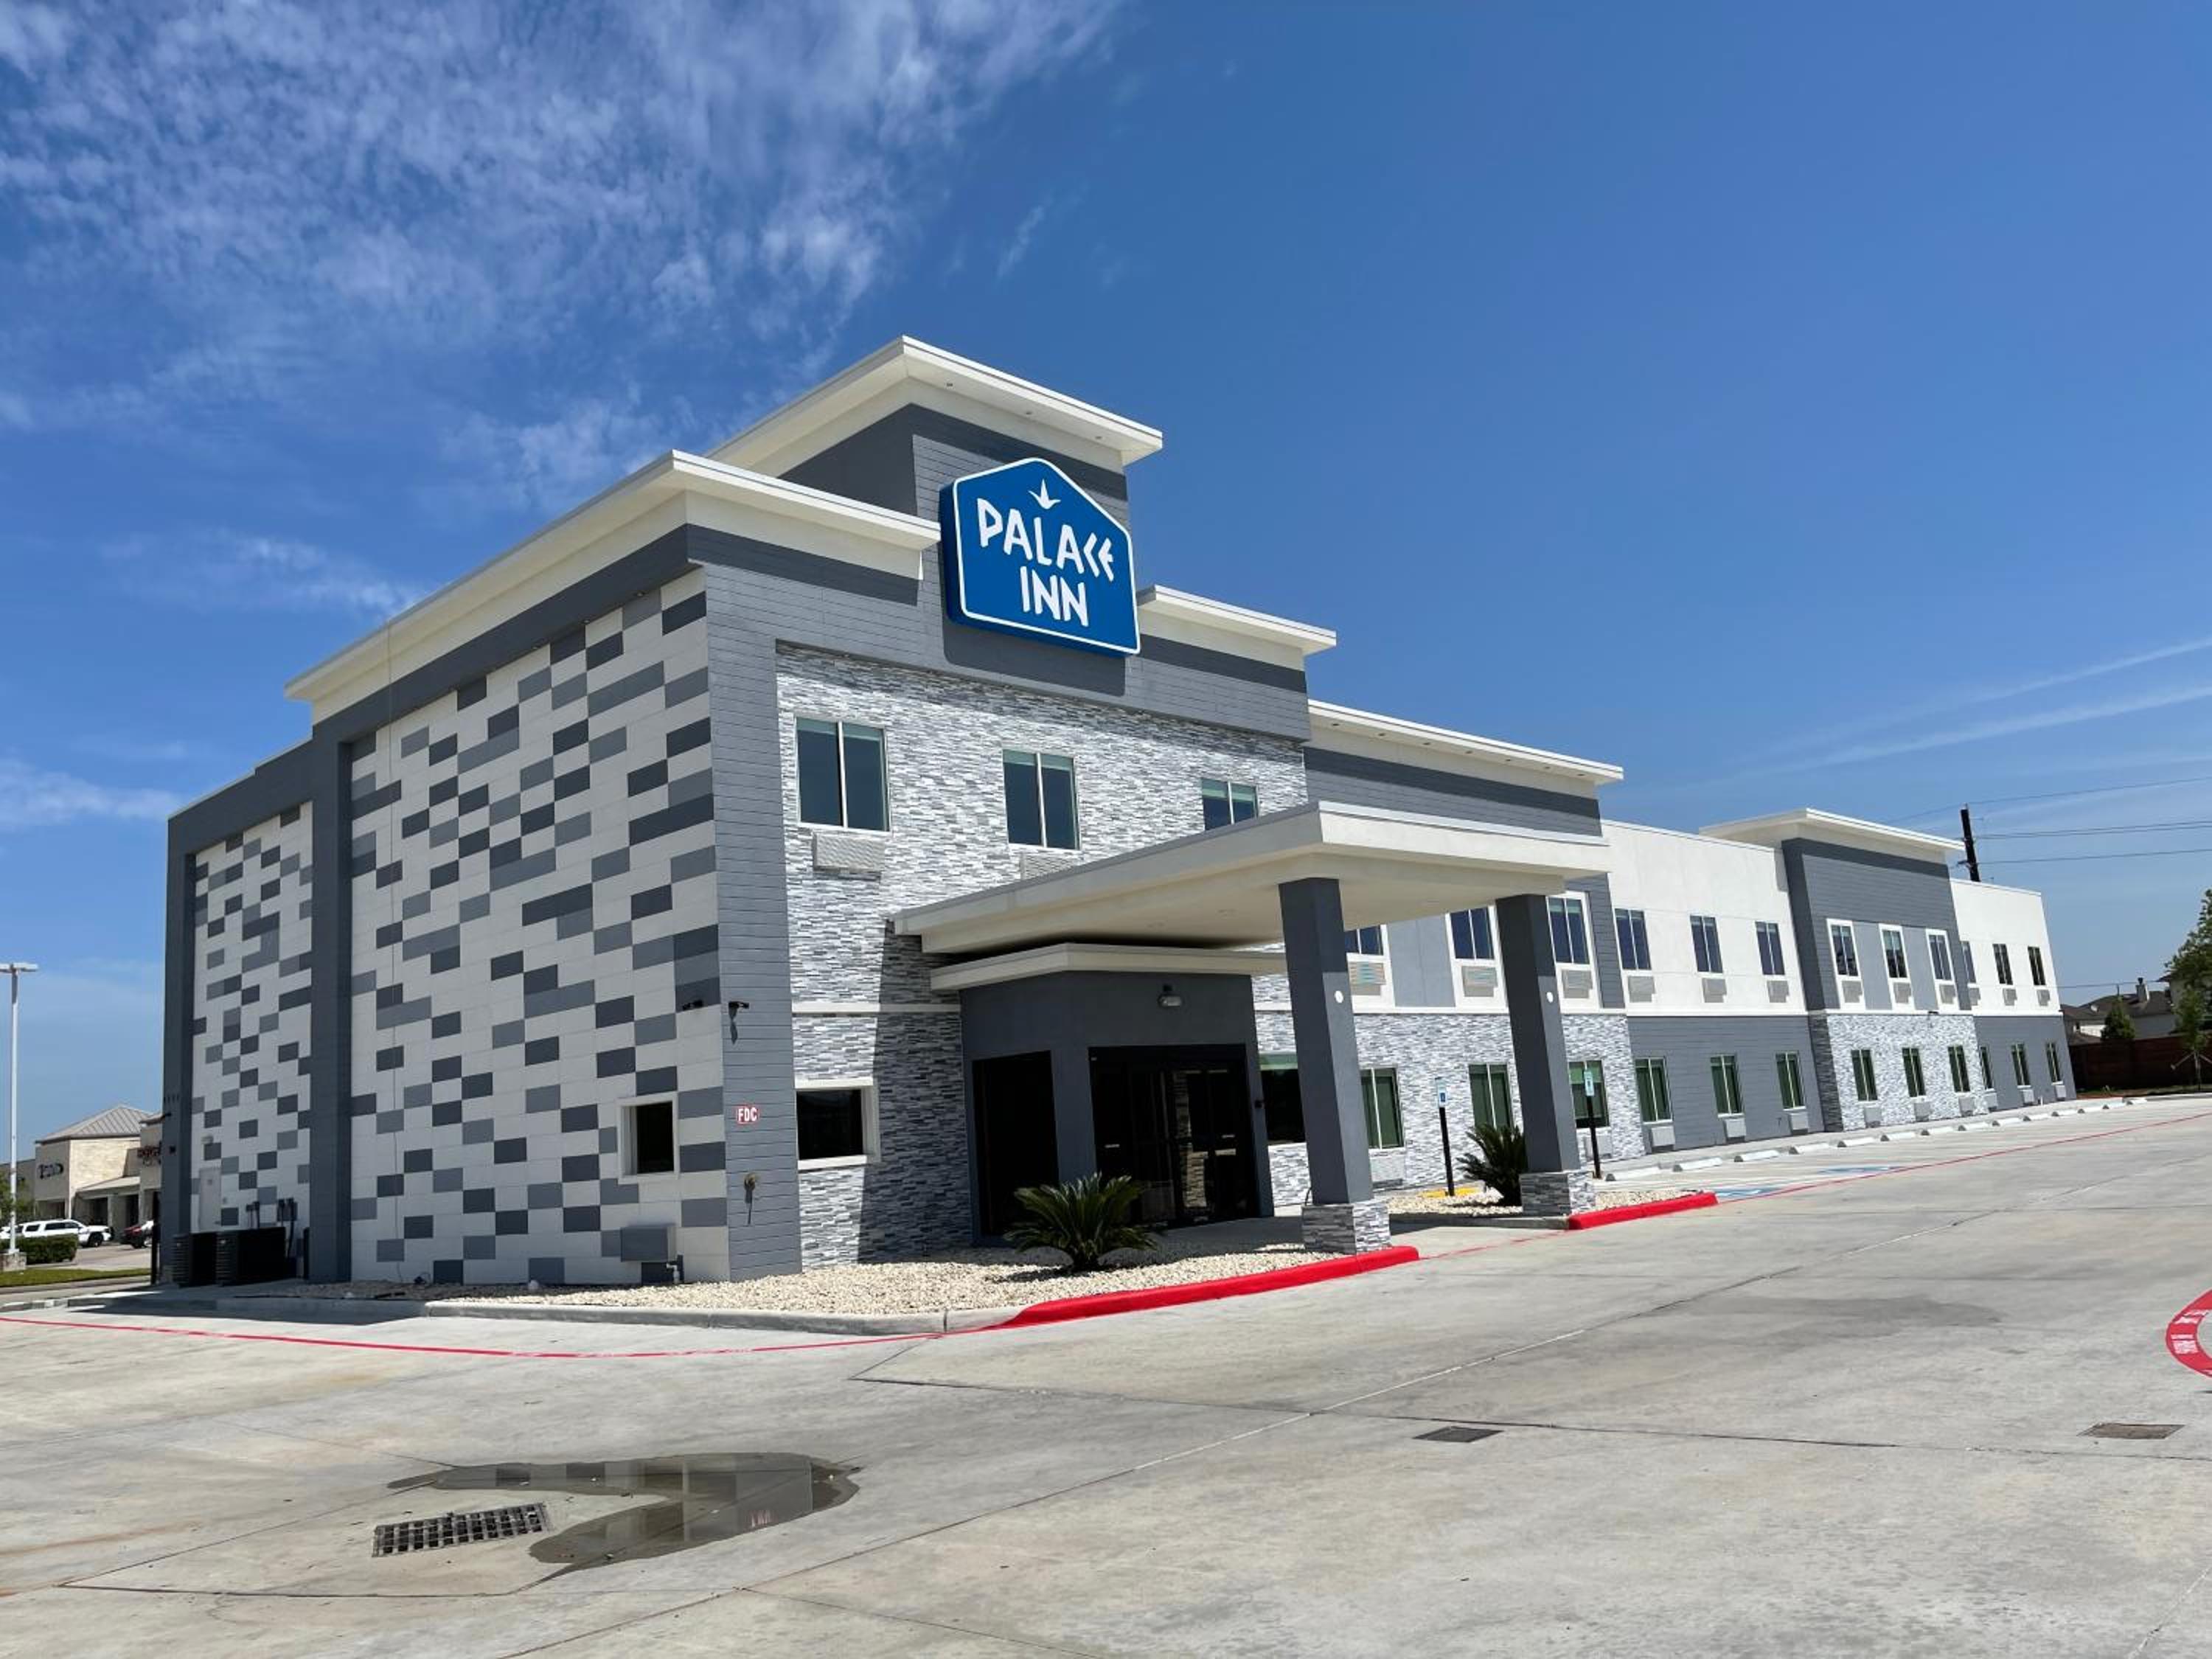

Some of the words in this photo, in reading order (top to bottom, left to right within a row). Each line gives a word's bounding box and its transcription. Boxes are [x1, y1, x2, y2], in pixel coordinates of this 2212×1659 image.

[977, 498, 1114, 582] PALACE
[1020, 566, 1089, 627] INN
[738, 1107, 758, 1121] FDC
